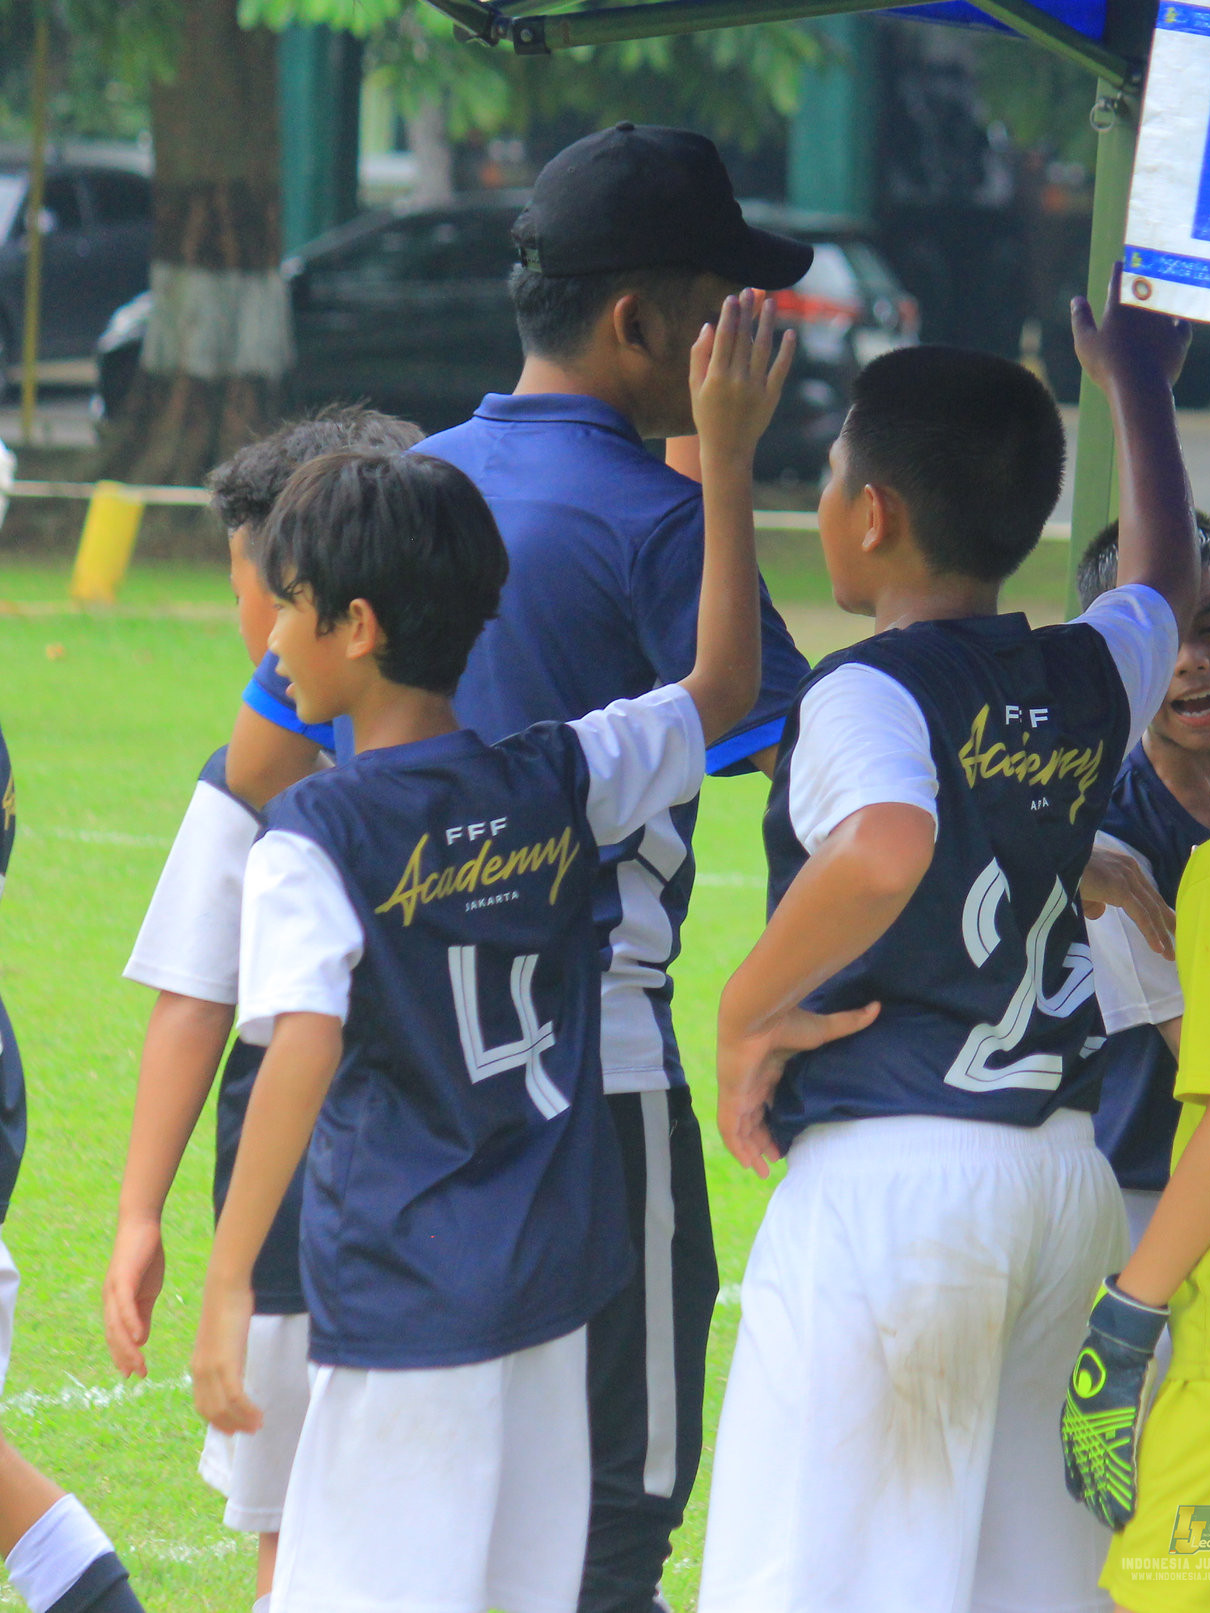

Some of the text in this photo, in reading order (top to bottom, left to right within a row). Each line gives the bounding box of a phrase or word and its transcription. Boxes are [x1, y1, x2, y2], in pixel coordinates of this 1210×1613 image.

[445, 816, 508, 846] FFF
[374, 826, 580, 927] Academy
[465, 890, 520, 913] JAKARTA
[448, 944, 571, 1120] 4
